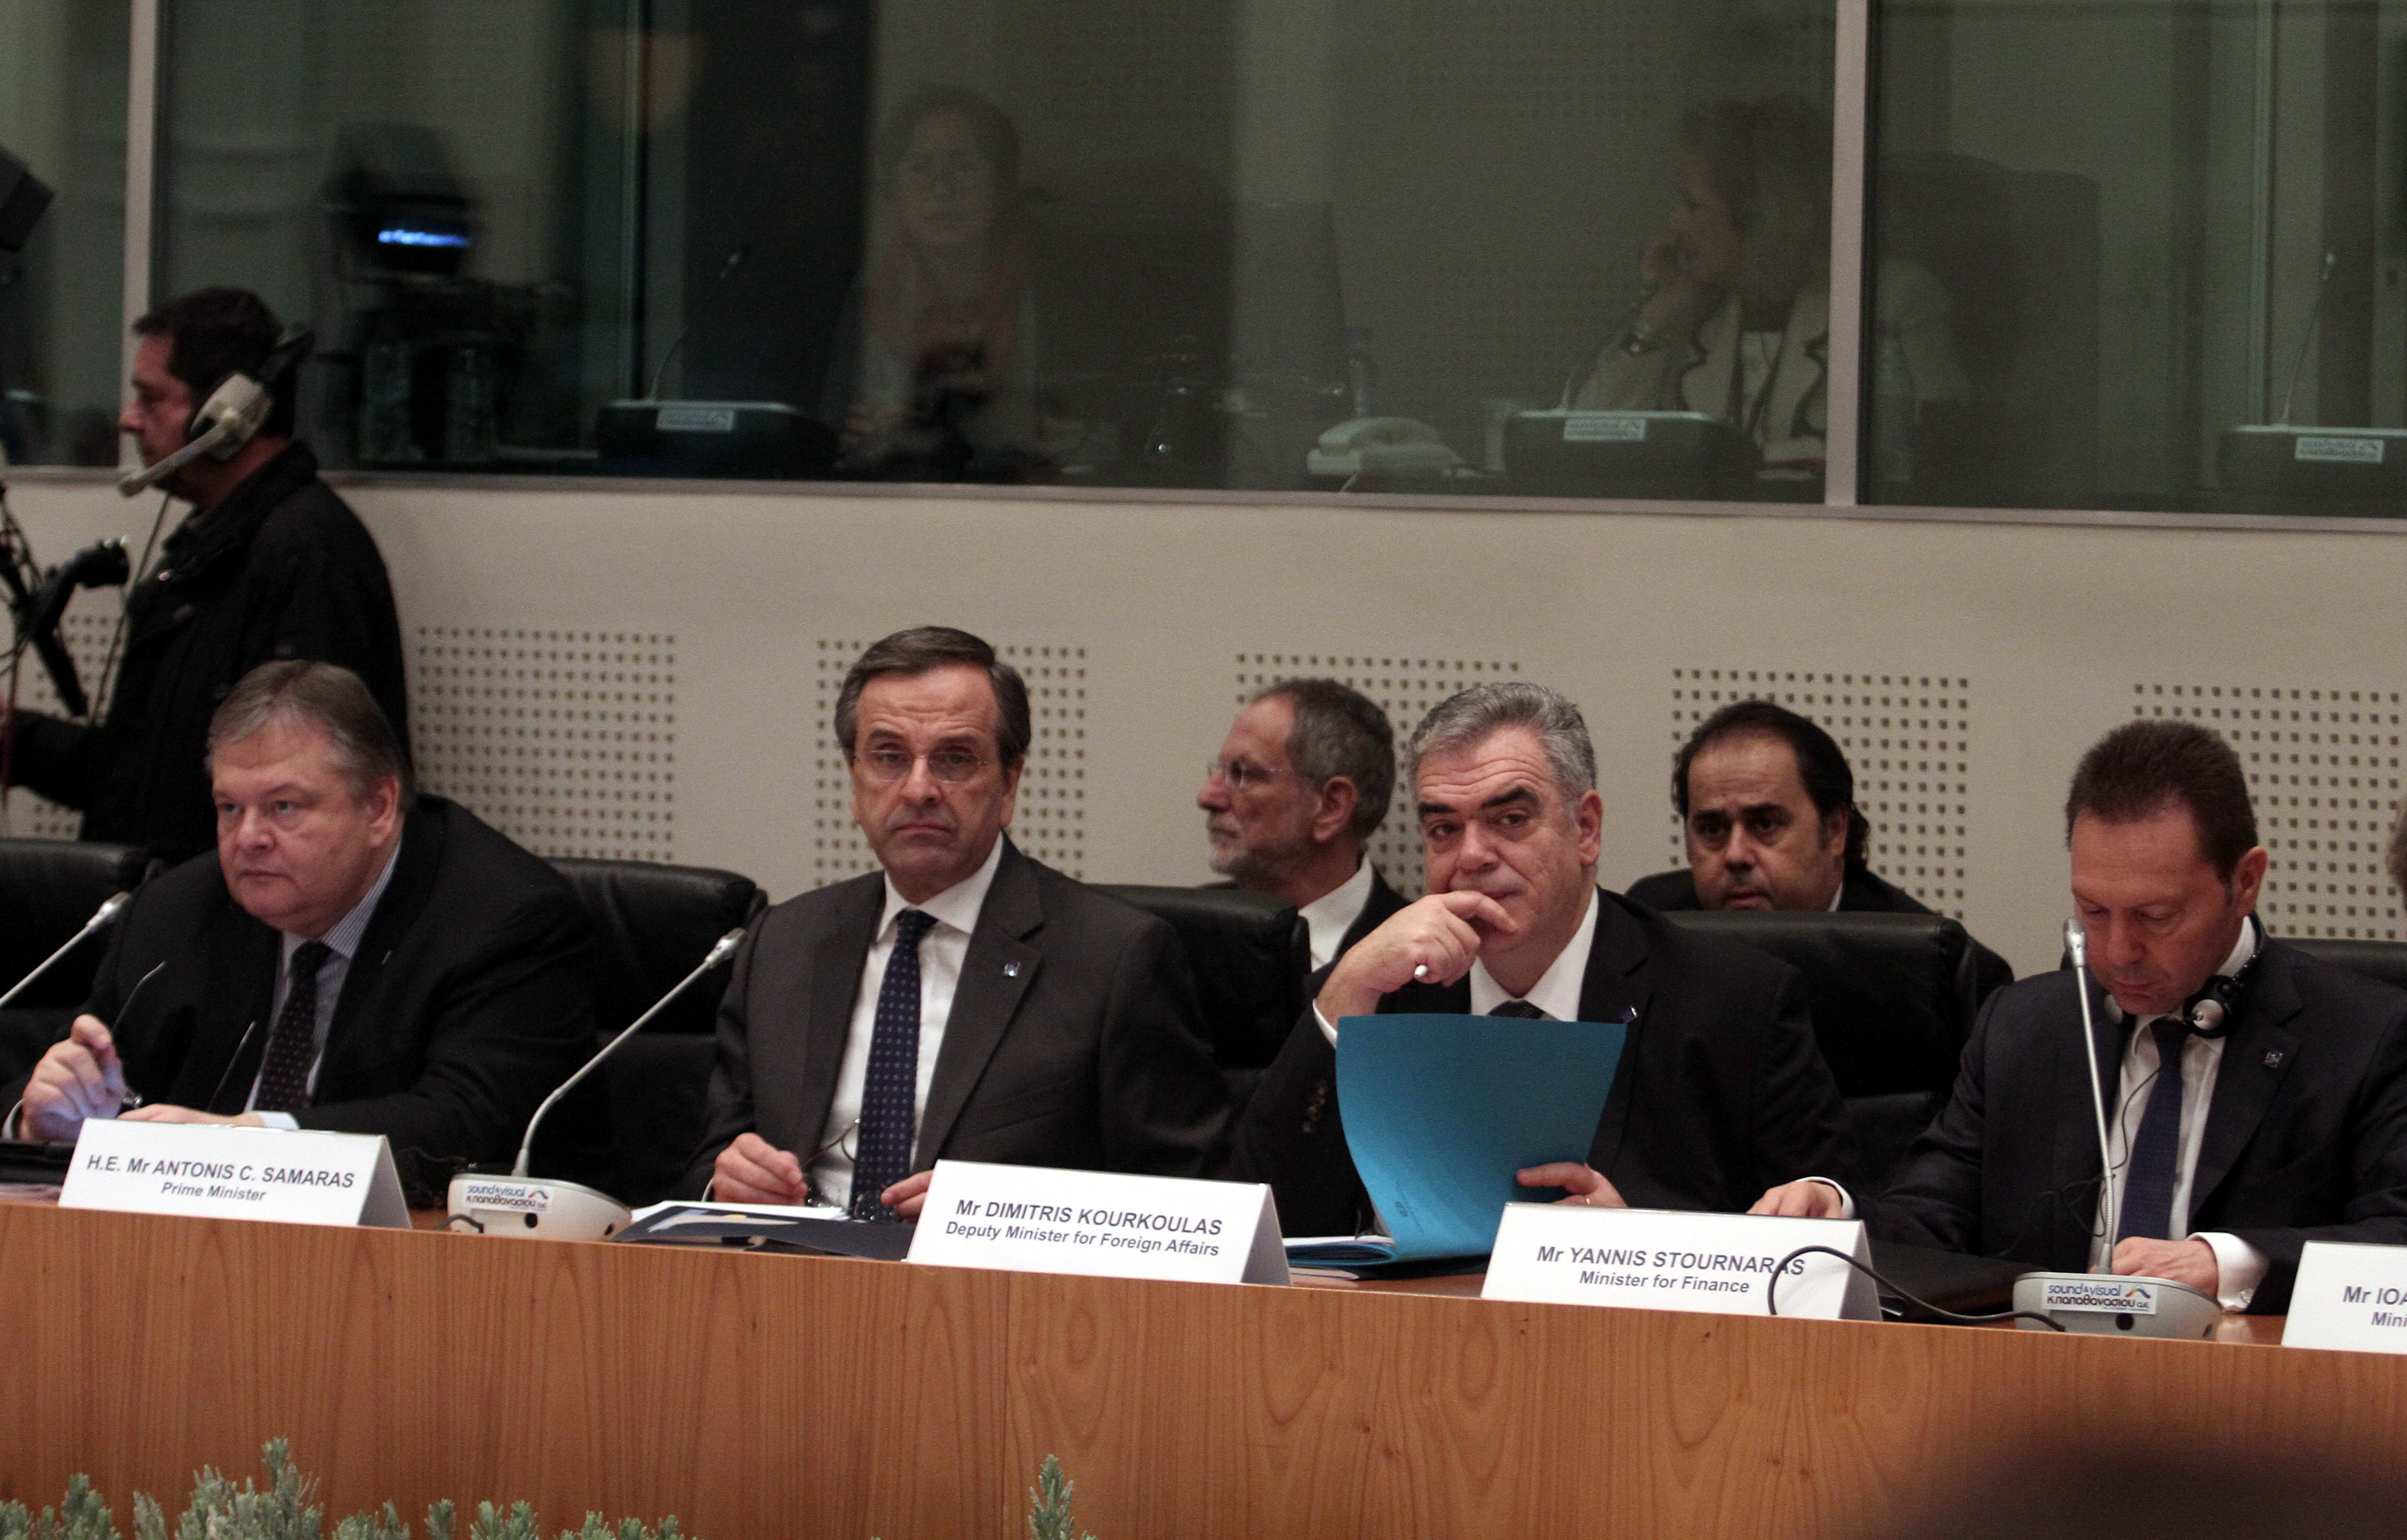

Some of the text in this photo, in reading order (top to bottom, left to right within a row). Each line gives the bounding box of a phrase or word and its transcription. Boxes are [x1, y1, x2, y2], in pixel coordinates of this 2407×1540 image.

[87, 1154, 354, 1188] H.E. Mr ANTONIS C. SAMARAS
[161, 1182, 266, 1201] Prime Minister
[956, 1200, 1222, 1235] Mr DIMITRIS KOURKOULAS
[946, 1221, 1219, 1257] Deputy Minister for Foreign Affairs
[1536, 1246, 1564, 1263] Mr
[1569, 1248, 1647, 1267] YANNIS
[1579, 1270, 1750, 1293] Minister for Finance
[2342, 1286, 2371, 1304] Mr
